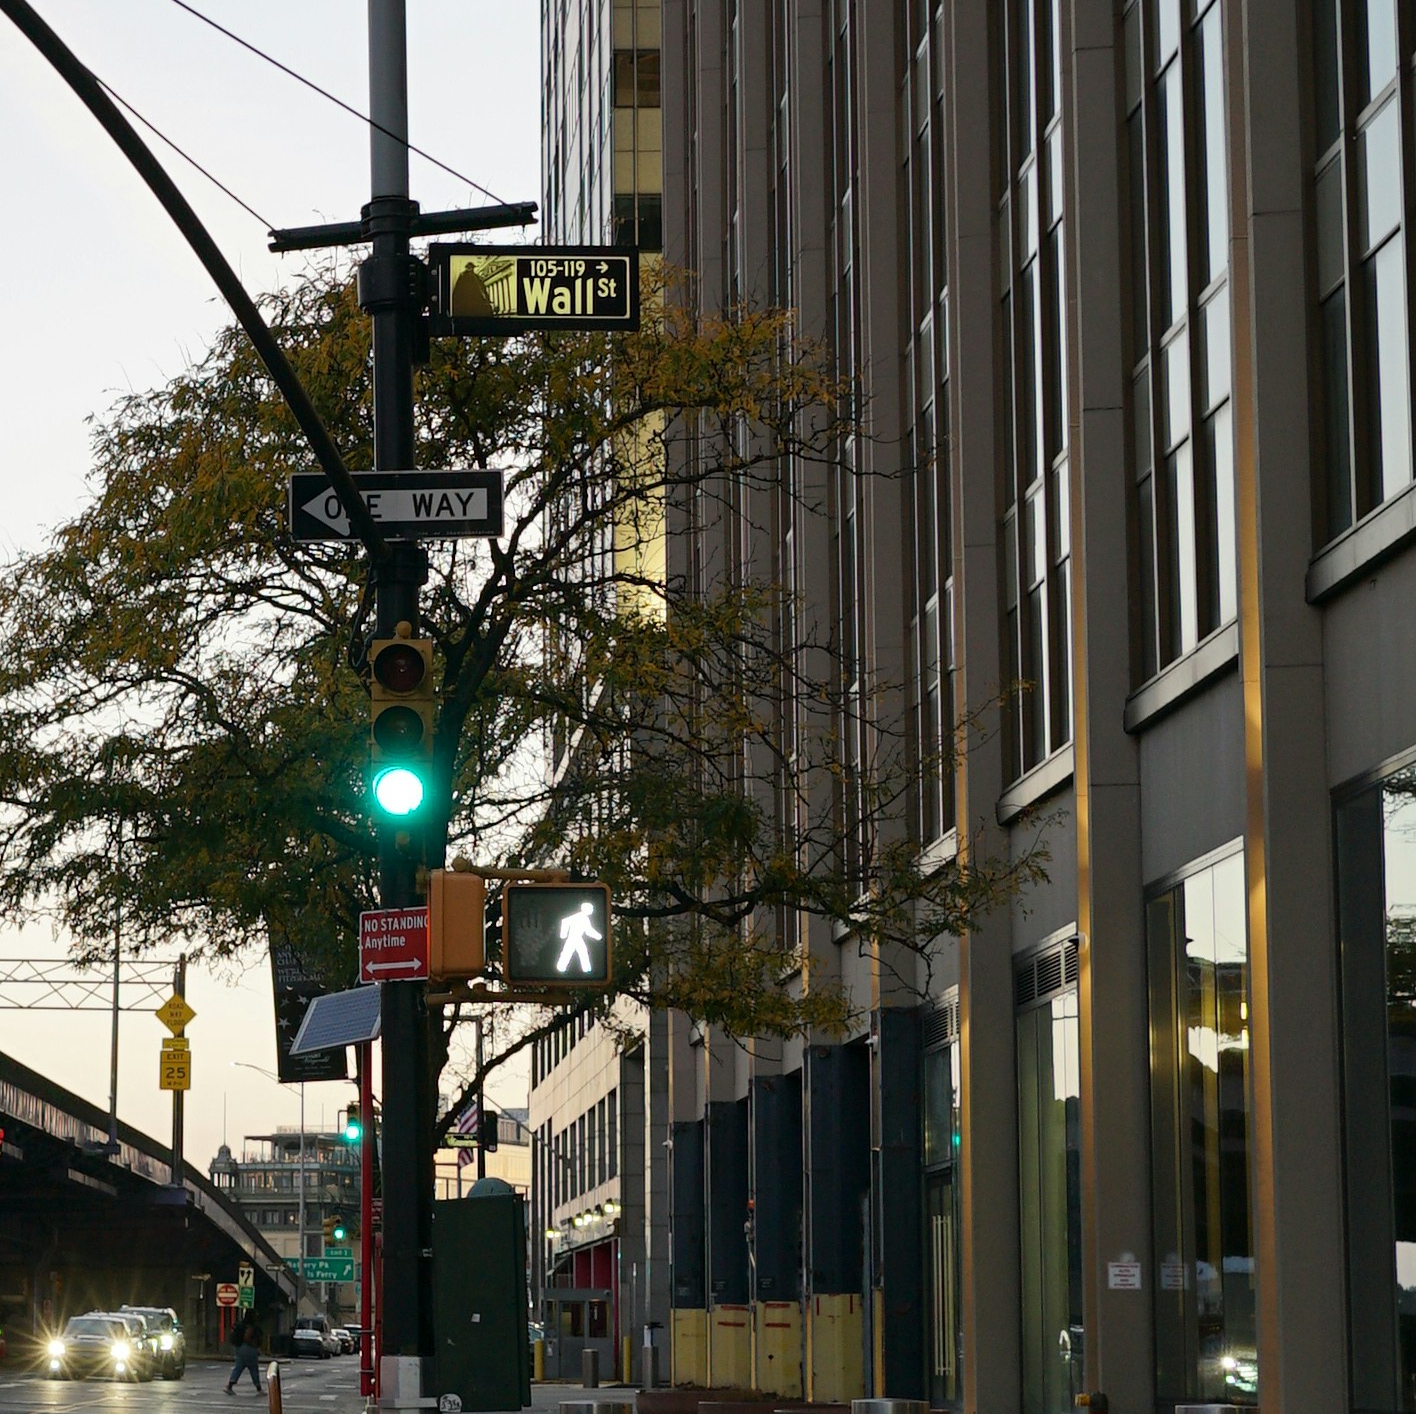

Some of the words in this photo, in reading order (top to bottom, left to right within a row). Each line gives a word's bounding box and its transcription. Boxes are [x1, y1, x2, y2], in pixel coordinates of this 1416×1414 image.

[530, 260, 586, 277] 105-119
[523, 277, 594, 315] Wall
[597, 277, 617, 298] St
[324, 494, 382, 519] OE
[412, 492, 474, 518] WAY
[364, 918, 378, 933] NO
[364, 934, 406, 951] Anytime
[165, 1067, 186, 1079] 25
